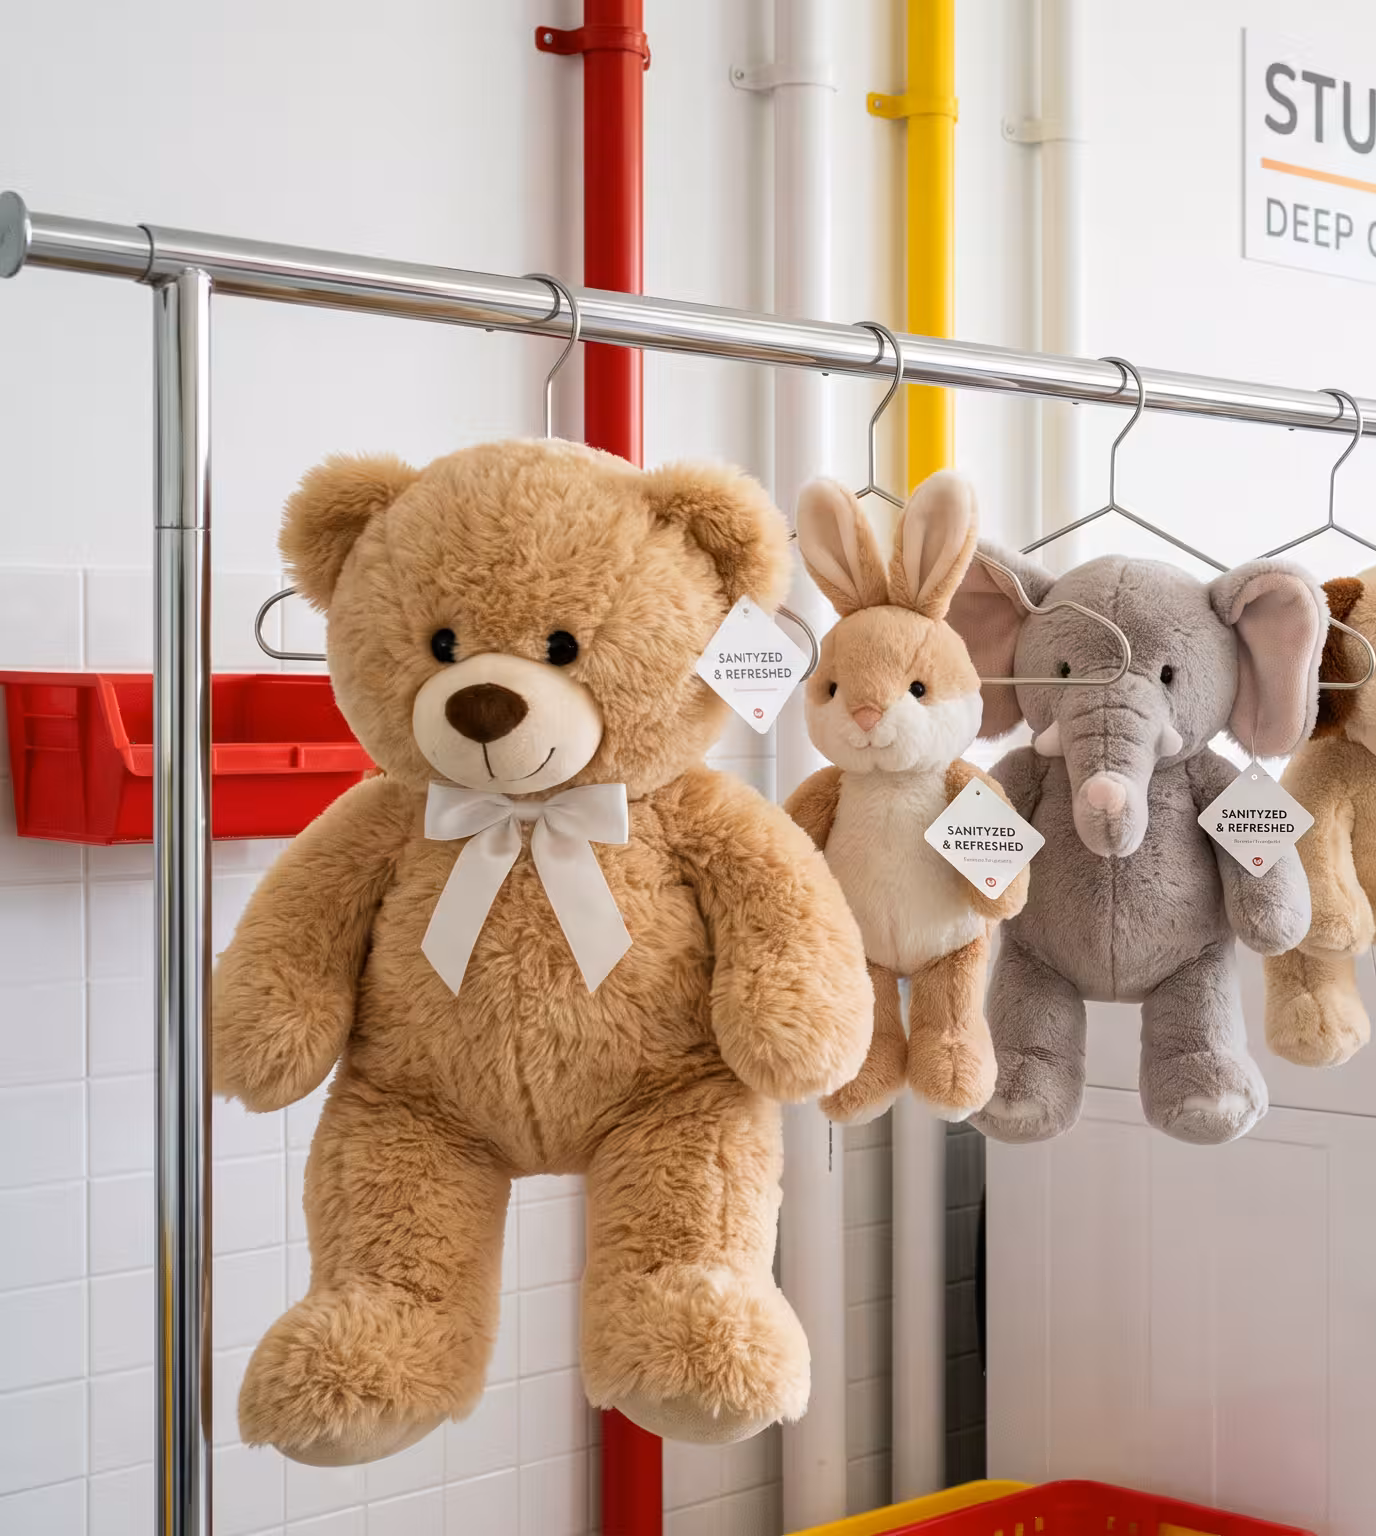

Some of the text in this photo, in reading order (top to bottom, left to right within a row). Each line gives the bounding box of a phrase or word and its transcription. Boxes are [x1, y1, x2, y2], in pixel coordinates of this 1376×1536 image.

[1265, 196, 1353, 252] DEEP
[718, 652, 783, 664] SANITYZED
[714, 668, 792, 680] & REFRESHED
[1222, 809, 1287, 819] SANITYZED
[947, 825, 1016, 837] SANITYZED
[1216, 822, 1295, 833] & REFRESHED
[942, 839, 1024, 852] & REFRESHED
